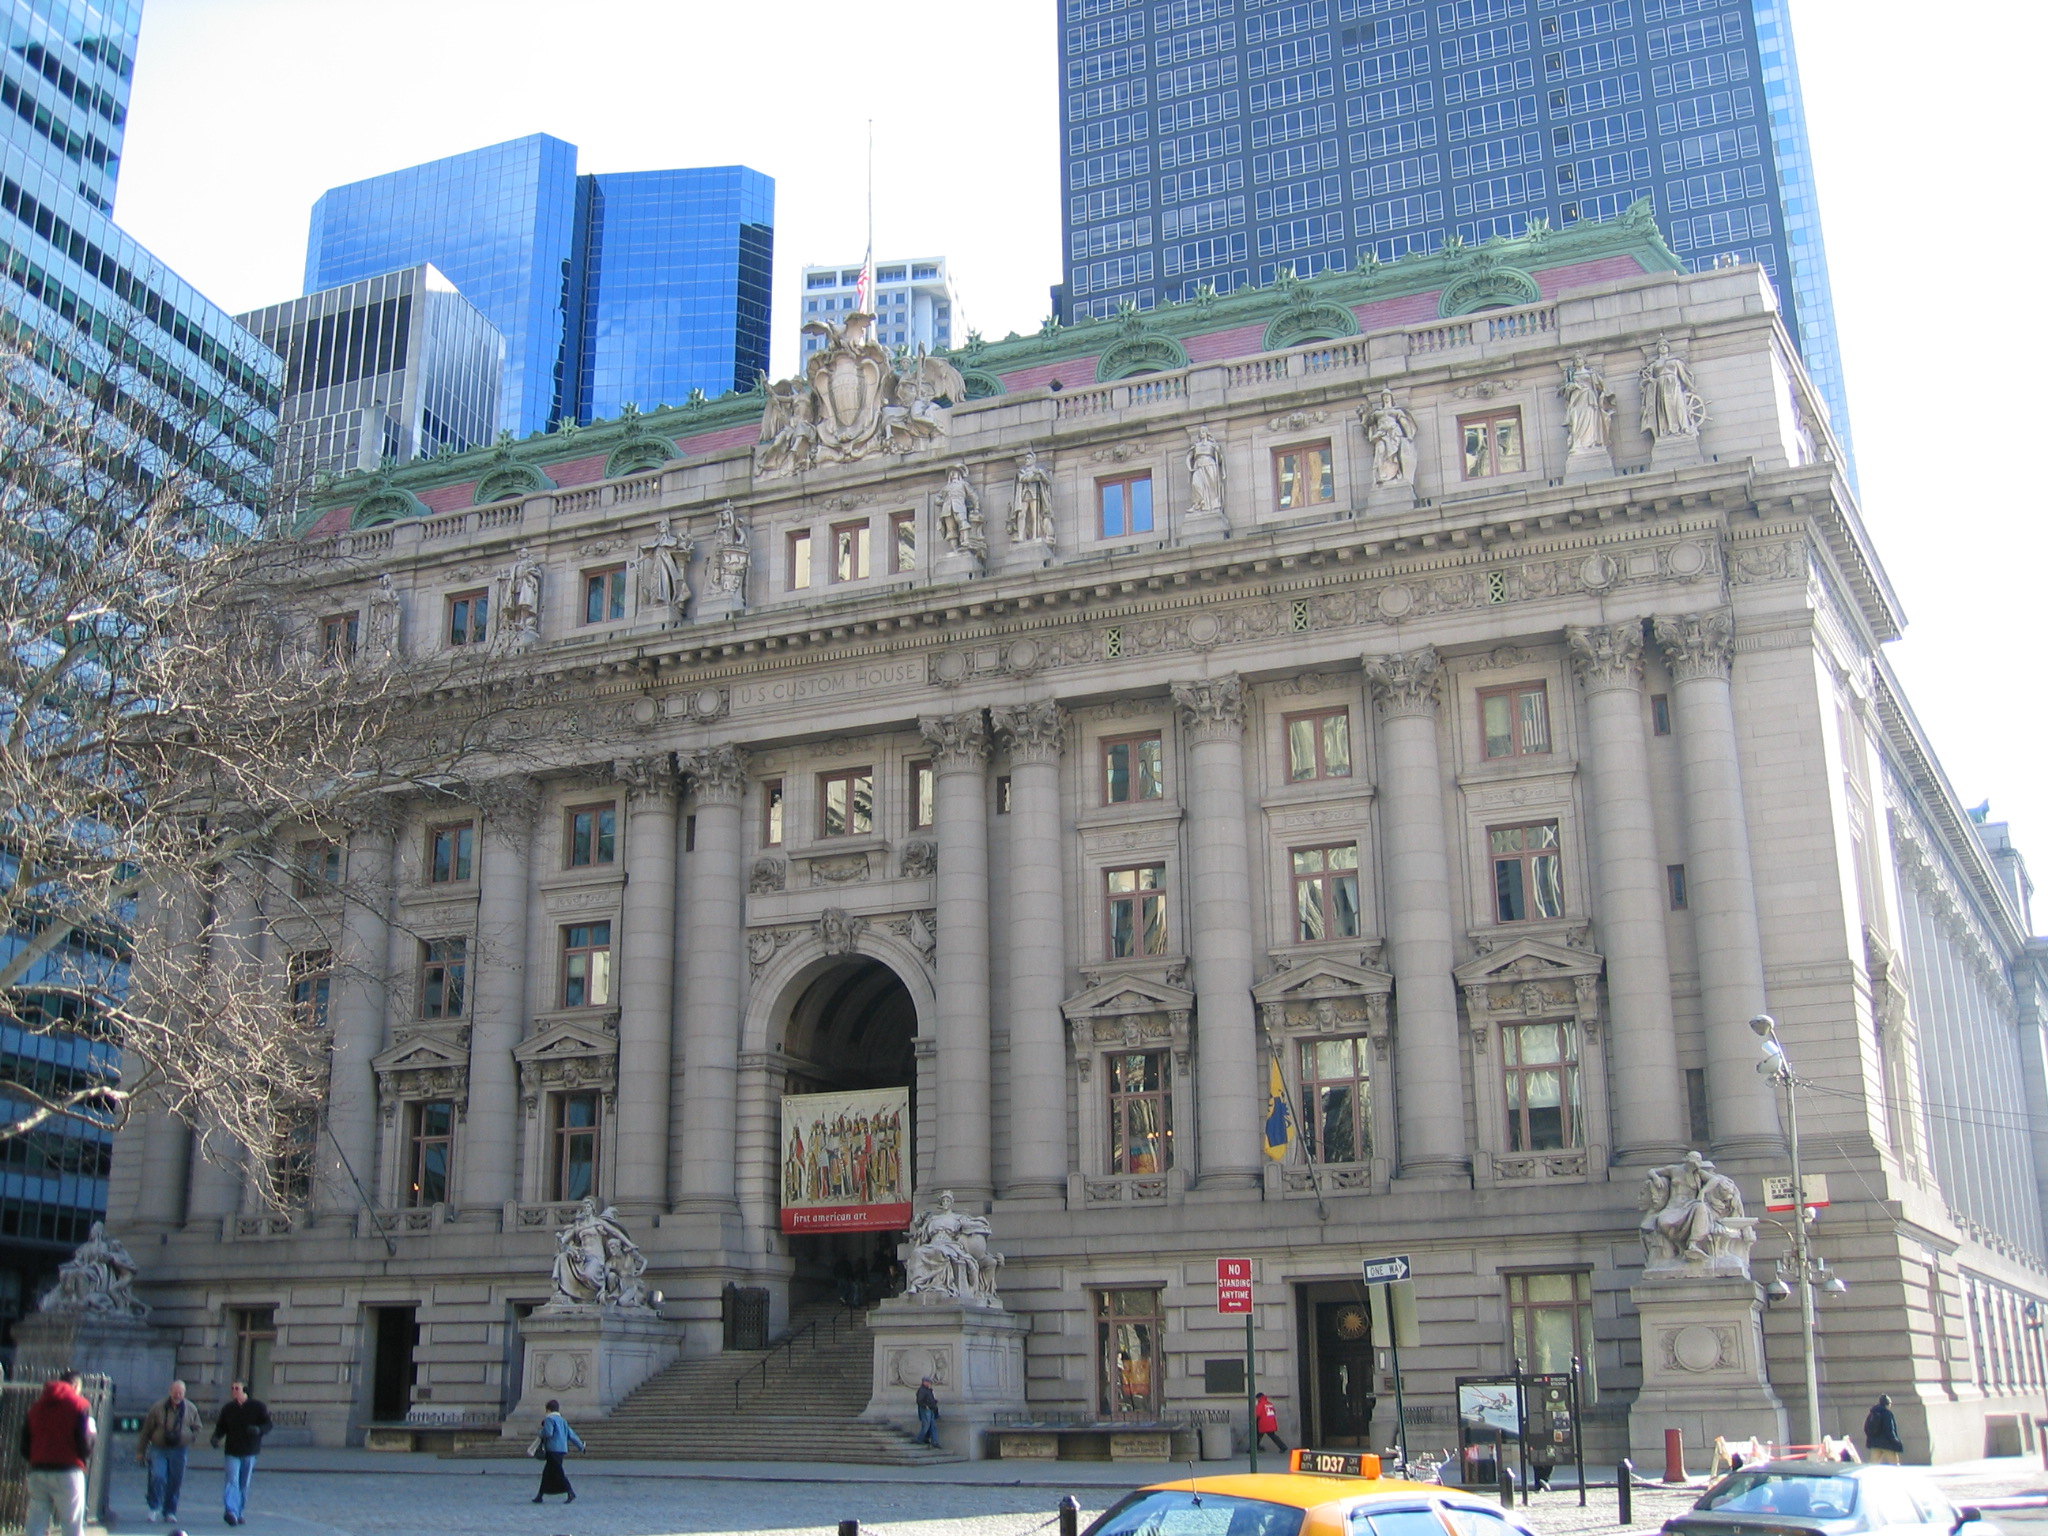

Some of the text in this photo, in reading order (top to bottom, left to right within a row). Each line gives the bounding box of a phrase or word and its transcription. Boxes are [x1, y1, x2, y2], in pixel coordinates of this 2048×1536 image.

[773, 674, 846, 699] CUSTOM
[793, 1212, 811, 1227] first
[812, 1211, 851, 1222] american
[853, 1212, 867, 1220] art
[1228, 1264, 1241, 1275] NO
[1370, 1263, 1404, 1277] ONE WAY
[1219, 1278, 1251, 1288] STANDING
[1221, 1290, 1249, 1299] ANYTIME
[1315, 1454, 1345, 1472] 1D37
